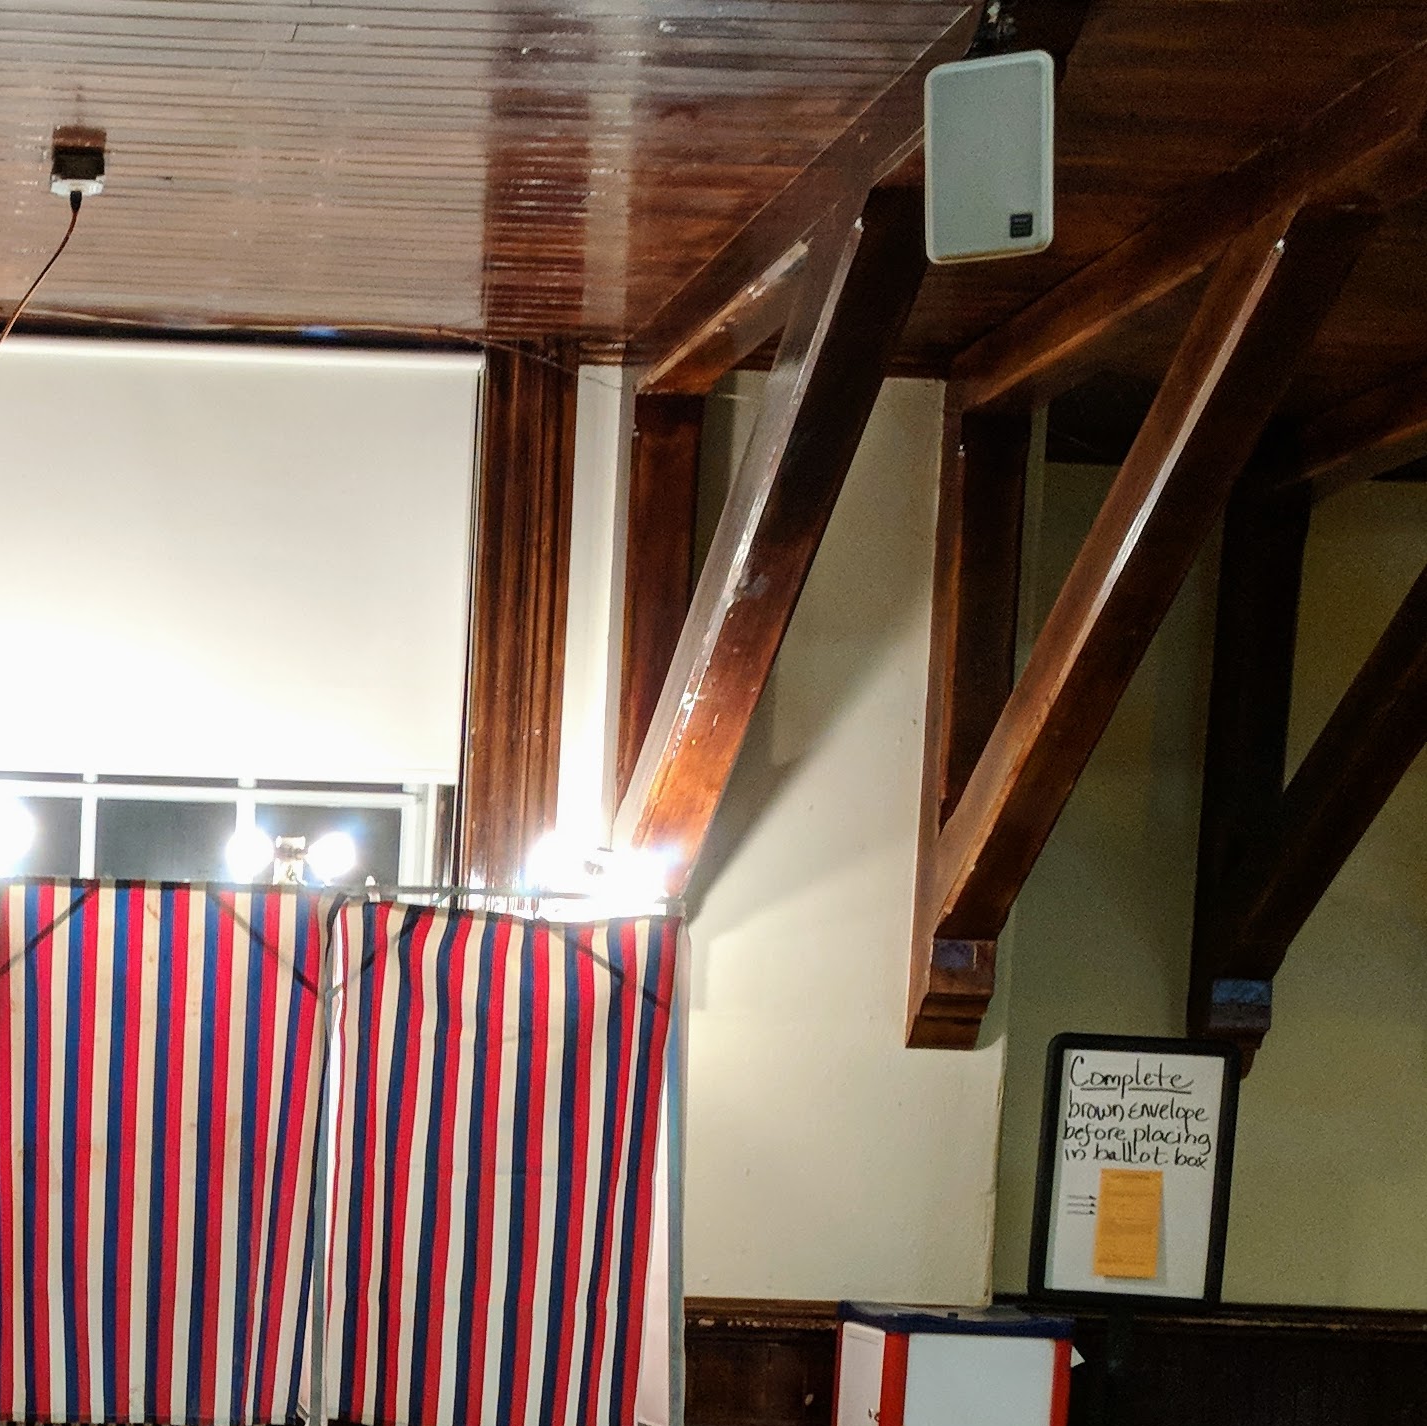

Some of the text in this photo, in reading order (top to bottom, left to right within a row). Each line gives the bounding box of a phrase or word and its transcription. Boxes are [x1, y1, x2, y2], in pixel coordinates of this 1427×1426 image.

[1070, 1055, 1194, 1099] Complete
[1067, 1089, 1125, 1122] brown
[1063, 1120, 1212, 1156] before placing
[1064, 1140, 1209, 1170] in ballot box
